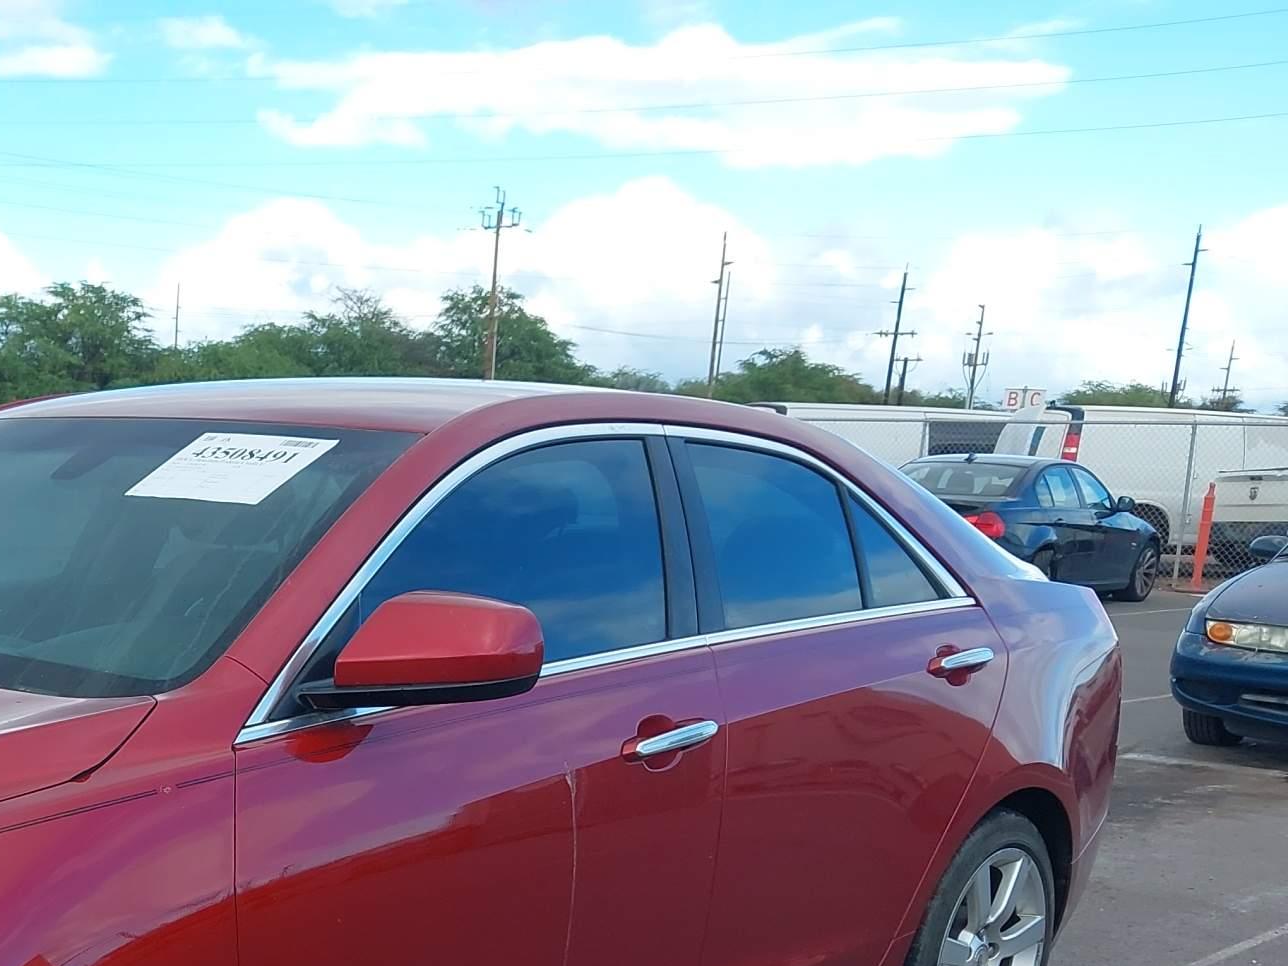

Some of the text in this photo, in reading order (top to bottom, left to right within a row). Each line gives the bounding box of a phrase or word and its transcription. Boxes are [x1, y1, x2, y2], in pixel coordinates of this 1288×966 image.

[1007, 391, 1019, 406] B
[1030, 392, 1041, 406] C
[191, 446, 300, 464] 43508491
